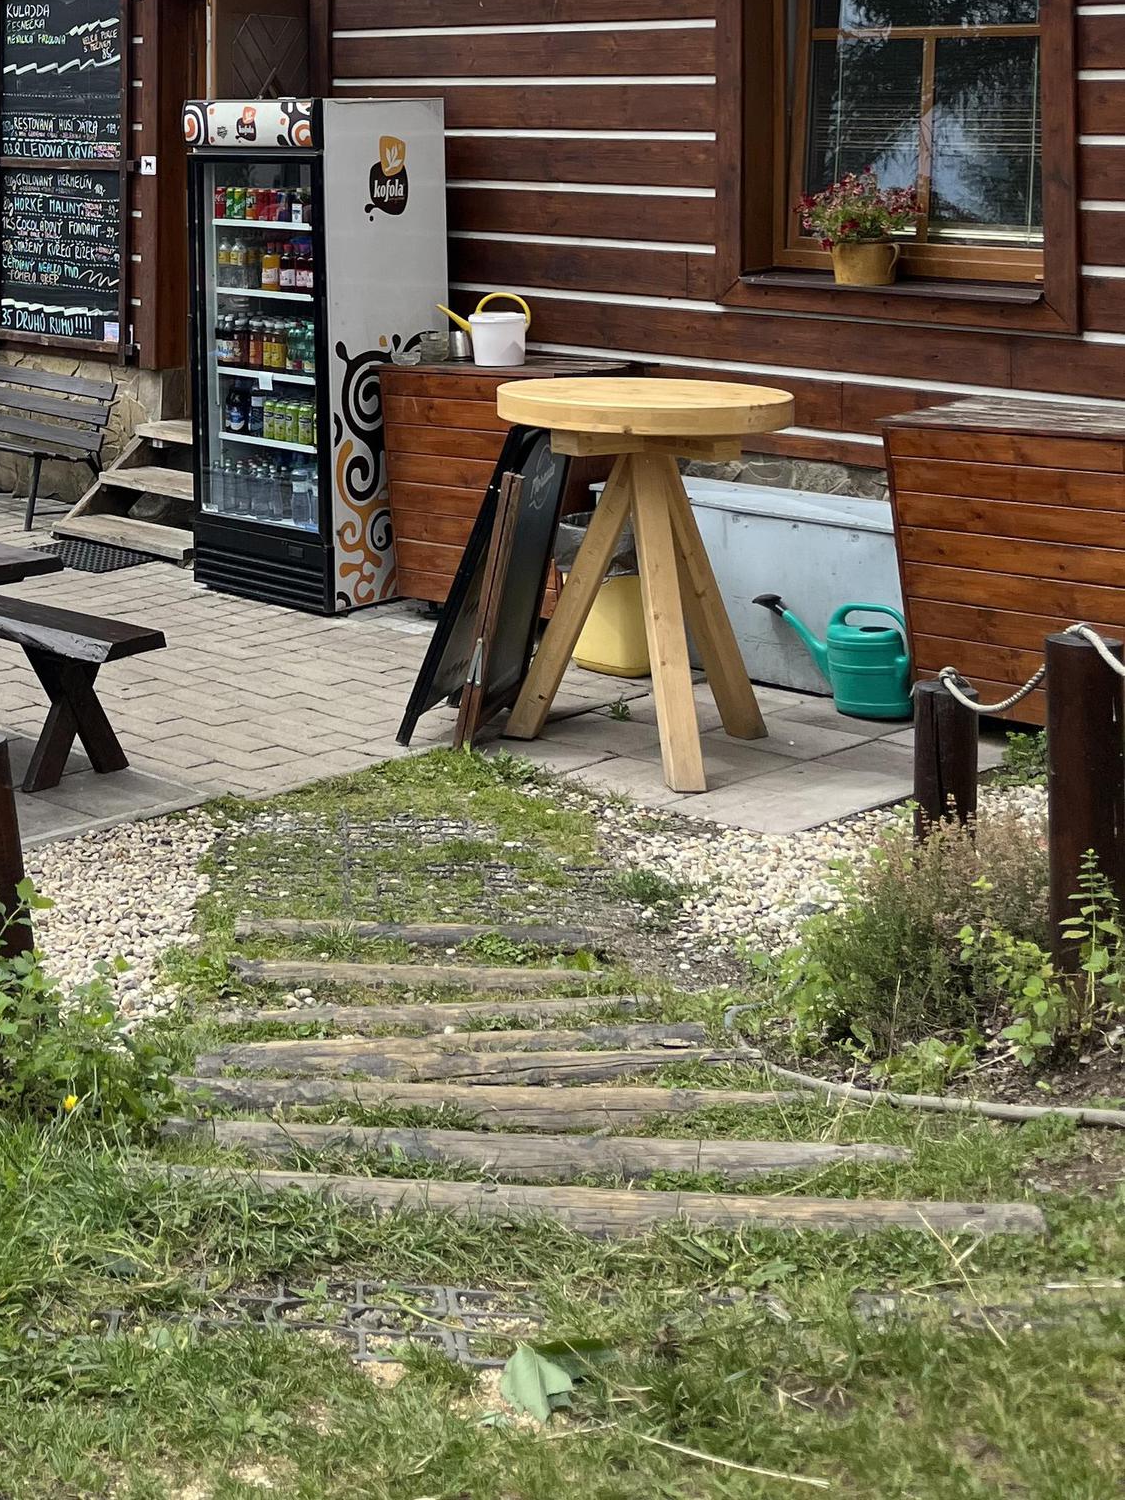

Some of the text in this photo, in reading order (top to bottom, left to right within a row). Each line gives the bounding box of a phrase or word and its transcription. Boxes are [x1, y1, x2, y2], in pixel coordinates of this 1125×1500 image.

[6, 3, 50, 18] KULAJDA
[373, 179, 404, 202] kofola
[14, 195, 44, 212] HORKÉ
[1, 308, 14, 326] 35
[16, 309, 46, 332] DRUHŮ
